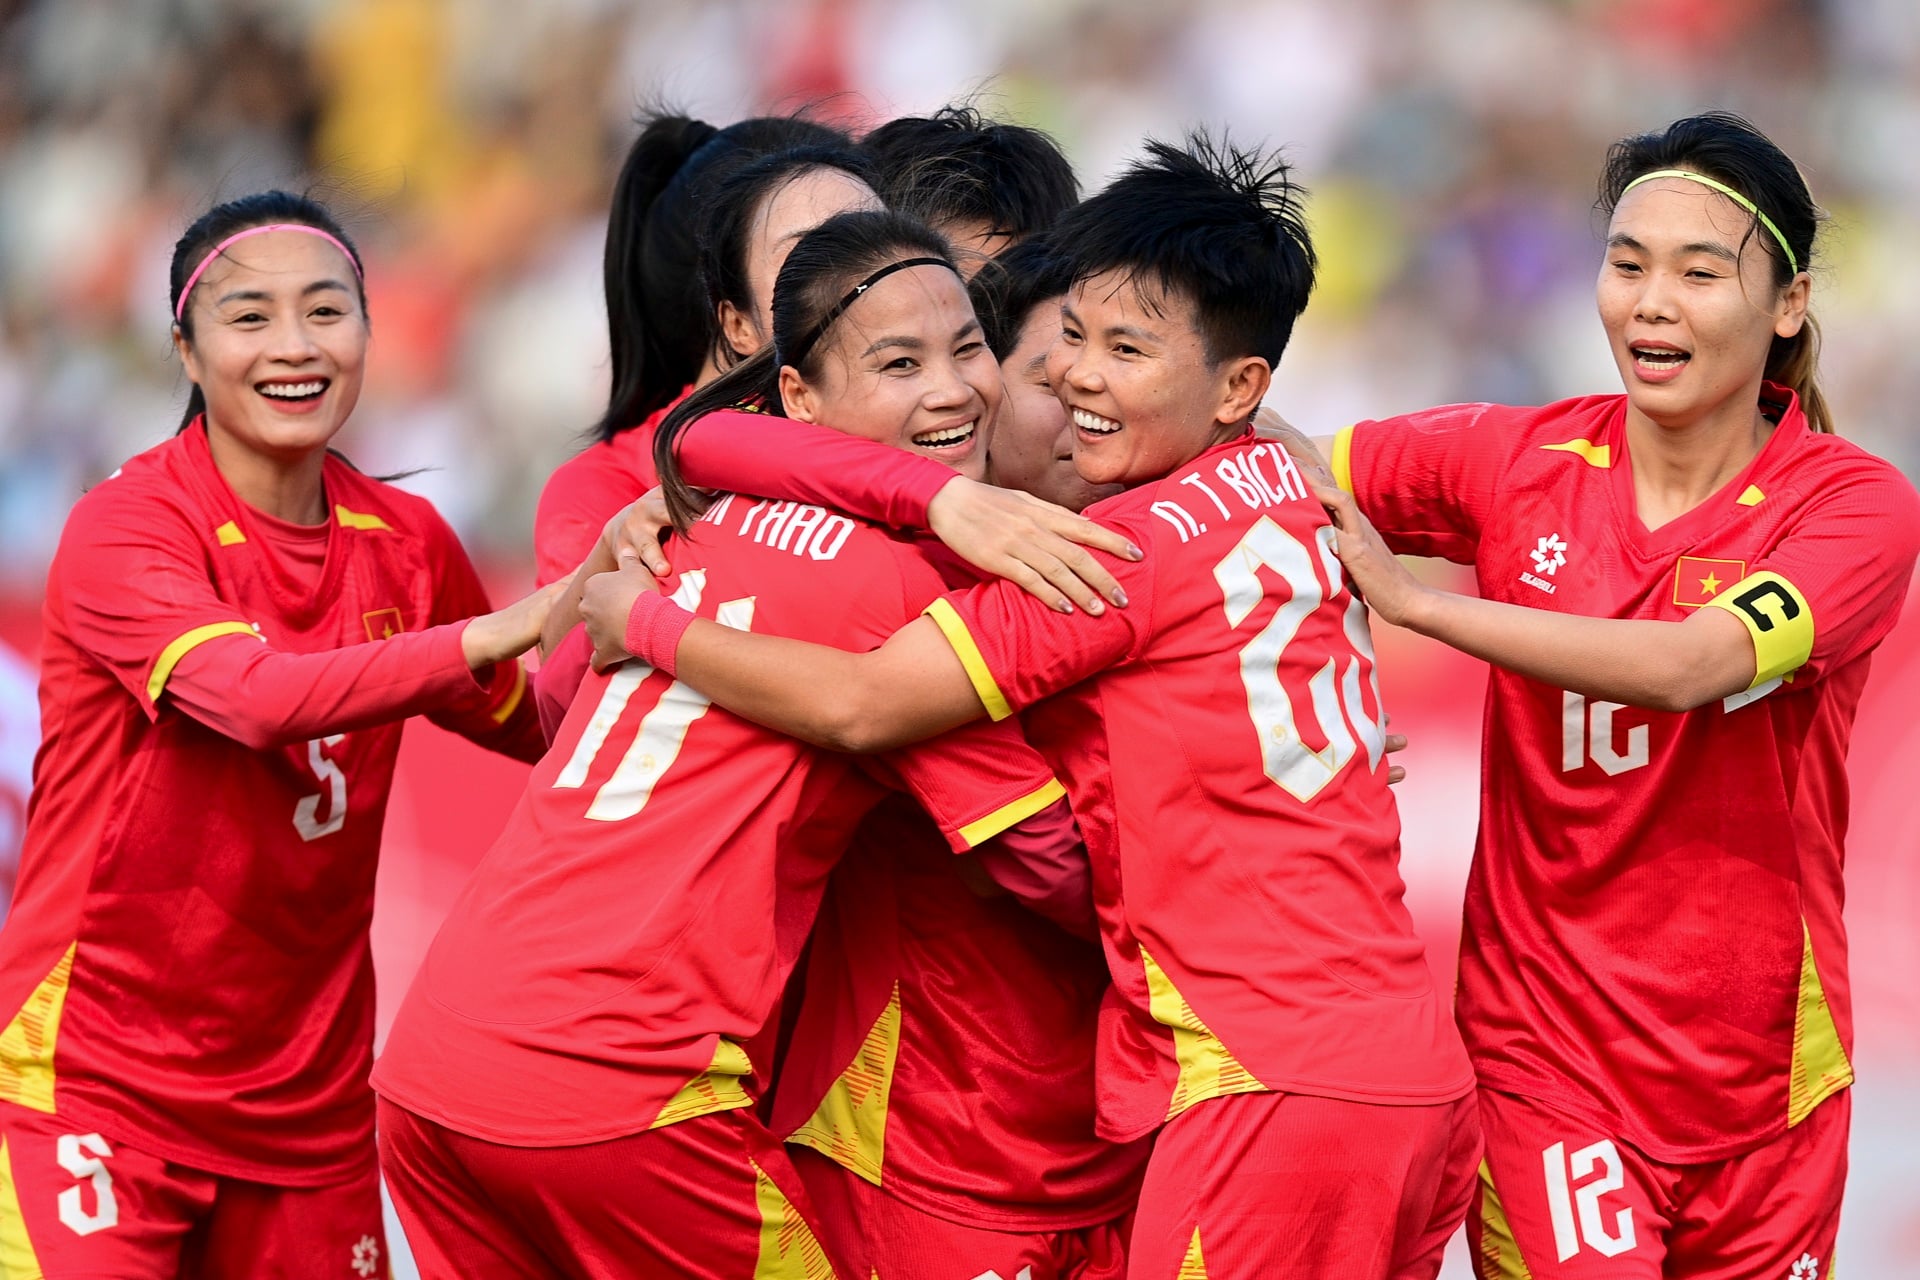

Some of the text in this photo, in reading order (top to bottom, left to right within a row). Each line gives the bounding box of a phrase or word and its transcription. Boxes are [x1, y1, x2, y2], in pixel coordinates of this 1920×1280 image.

[1180, 472, 1231, 521] T
[1215, 442, 1307, 510] BICH
[1732, 580, 1800, 632] C
[292, 733, 347, 842] 5
[57, 1132, 118, 1236] 5
[1542, 1139, 1637, 1263] 12
